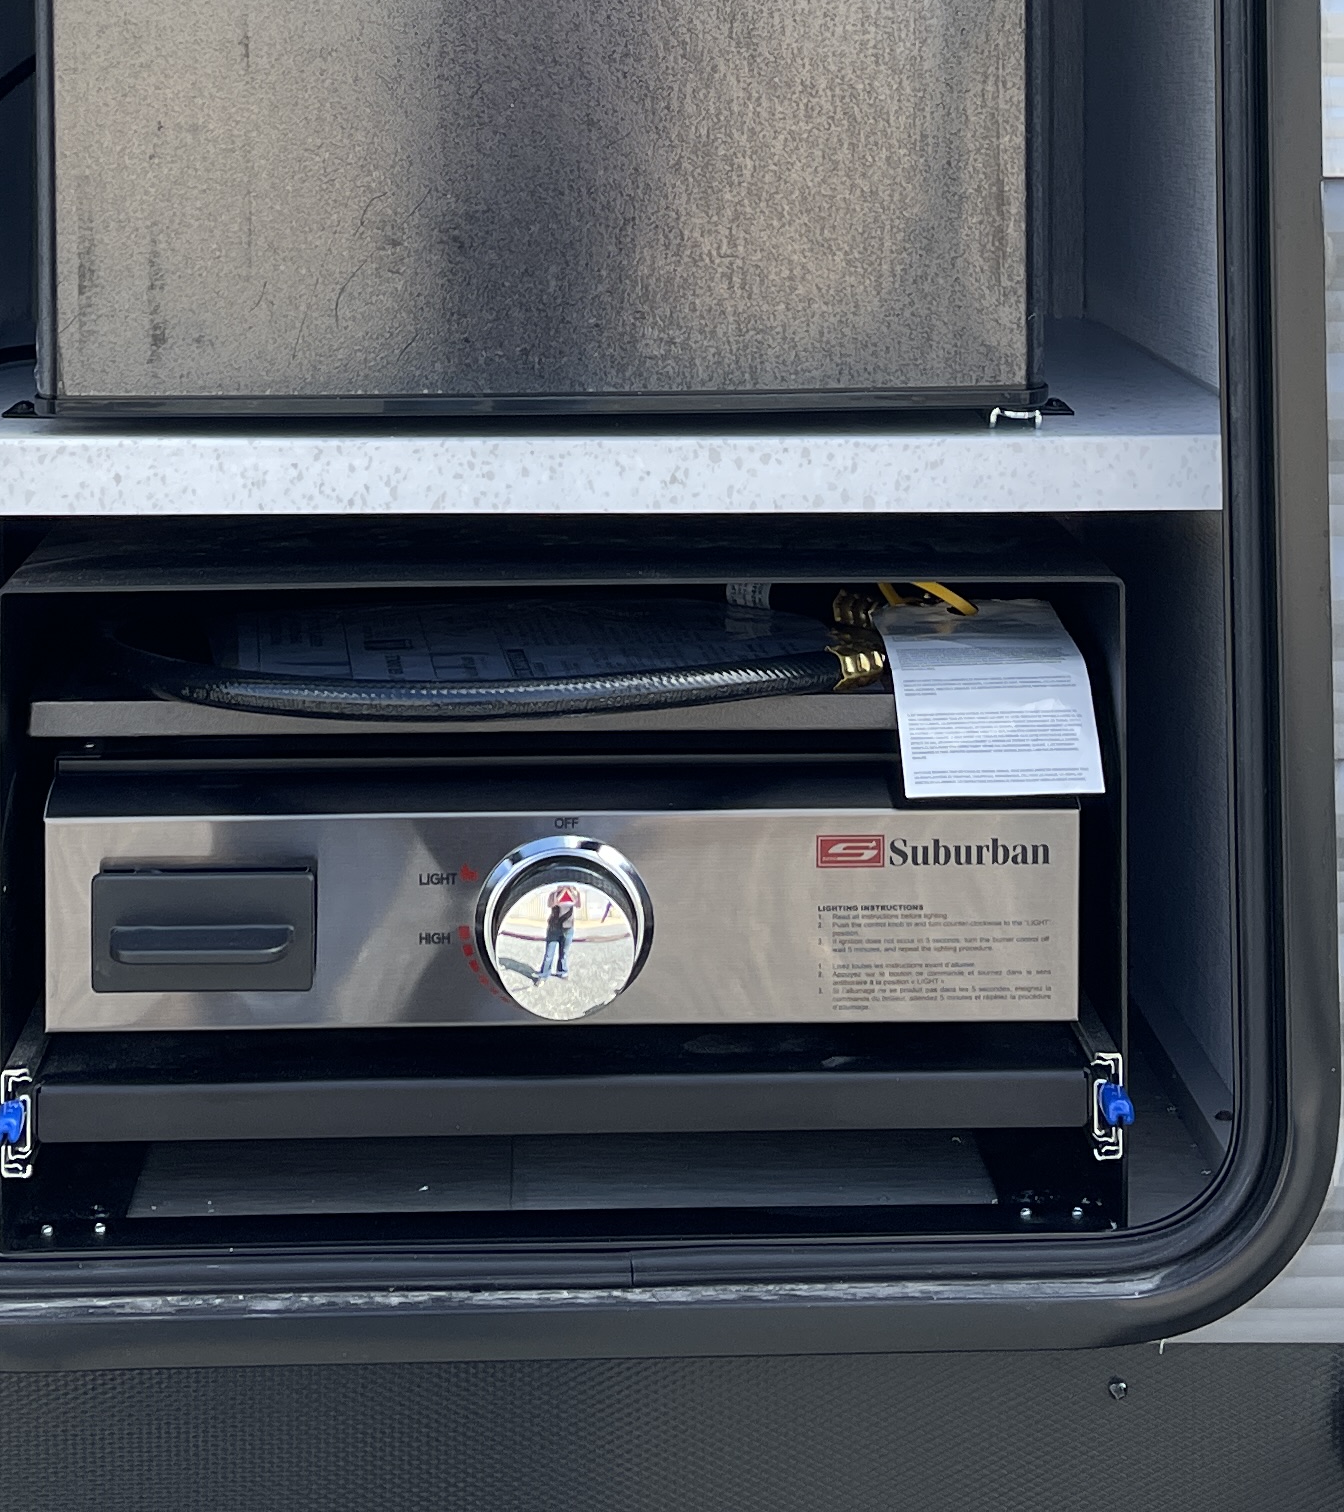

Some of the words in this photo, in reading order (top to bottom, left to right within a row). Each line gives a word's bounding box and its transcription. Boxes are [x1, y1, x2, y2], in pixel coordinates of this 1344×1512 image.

[554, 817, 579, 829] OFF
[889, 837, 1051, 867] Suburban
[419, 873, 457, 886] LIGHT
[818, 904, 859, 912] LIGHTING
[861, 904, 925, 912] INSTRUCTIONS
[419, 932, 451, 945] HIGH
